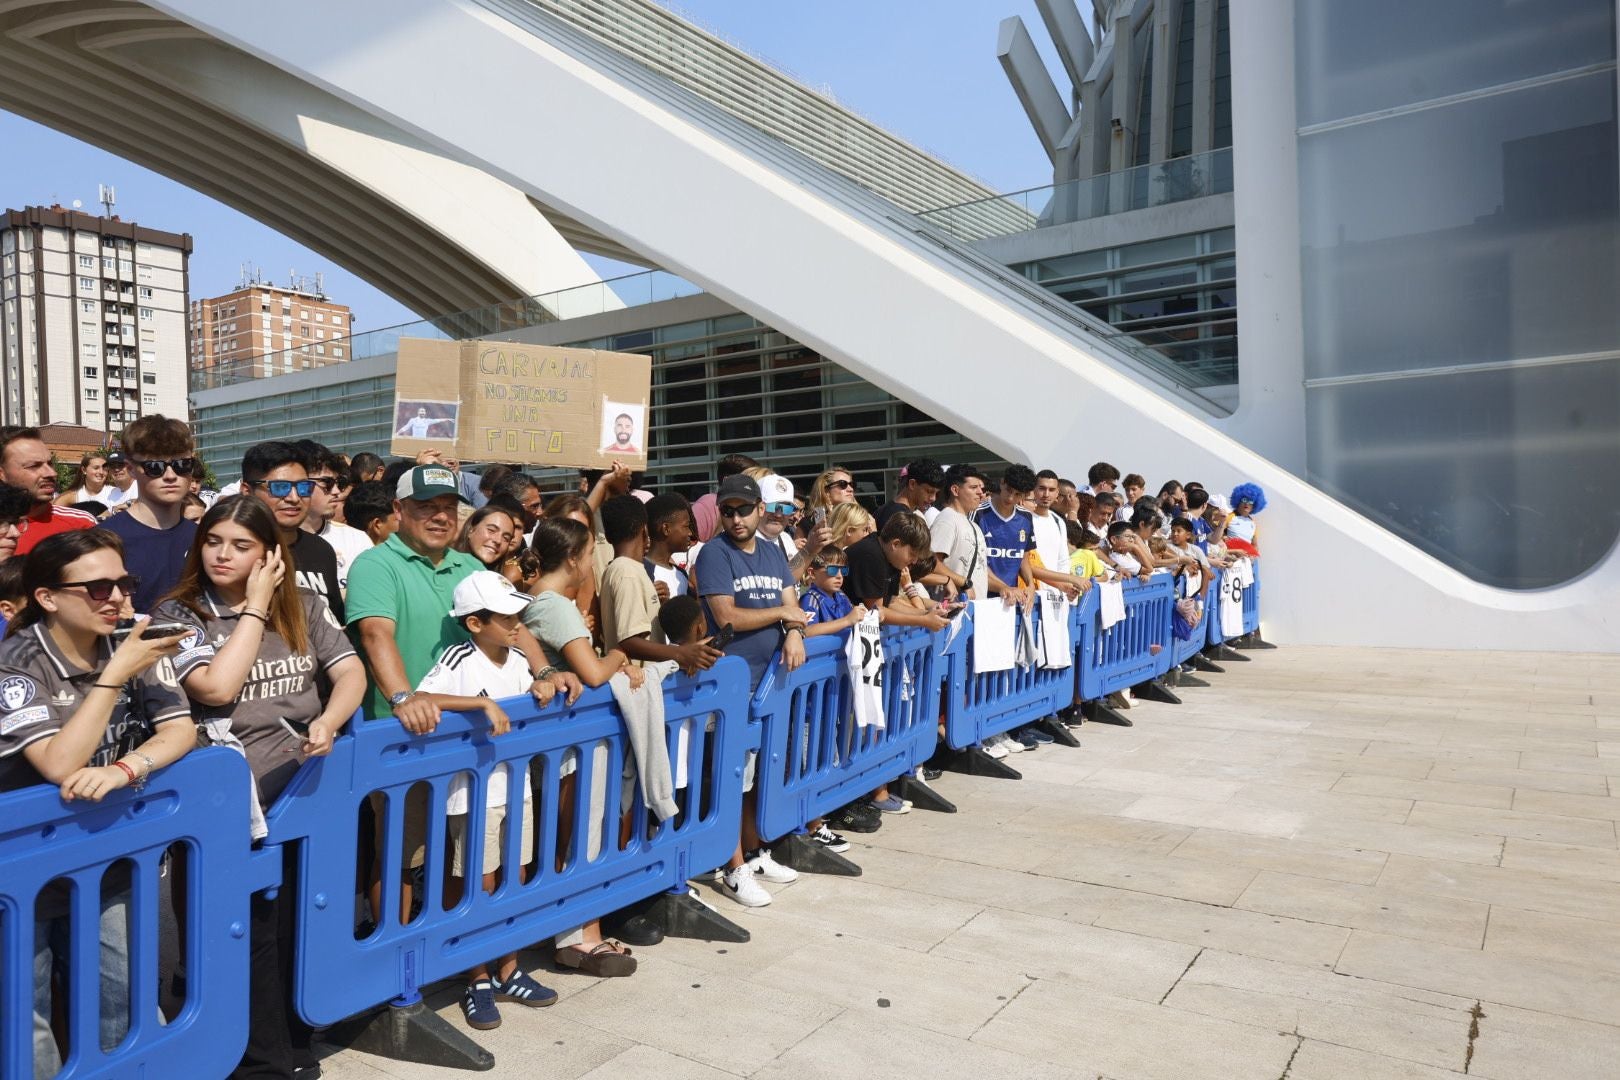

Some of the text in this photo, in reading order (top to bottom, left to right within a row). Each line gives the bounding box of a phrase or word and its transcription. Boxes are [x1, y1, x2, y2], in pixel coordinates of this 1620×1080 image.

[480, 348, 592, 378] CARVAJAL
[487, 429, 563, 453] FOTO
[295, 570, 328, 595] AN
[245, 654, 313, 683] irates
[9, 690, 21, 701] 15
[260, 675, 304, 699] BETTER
